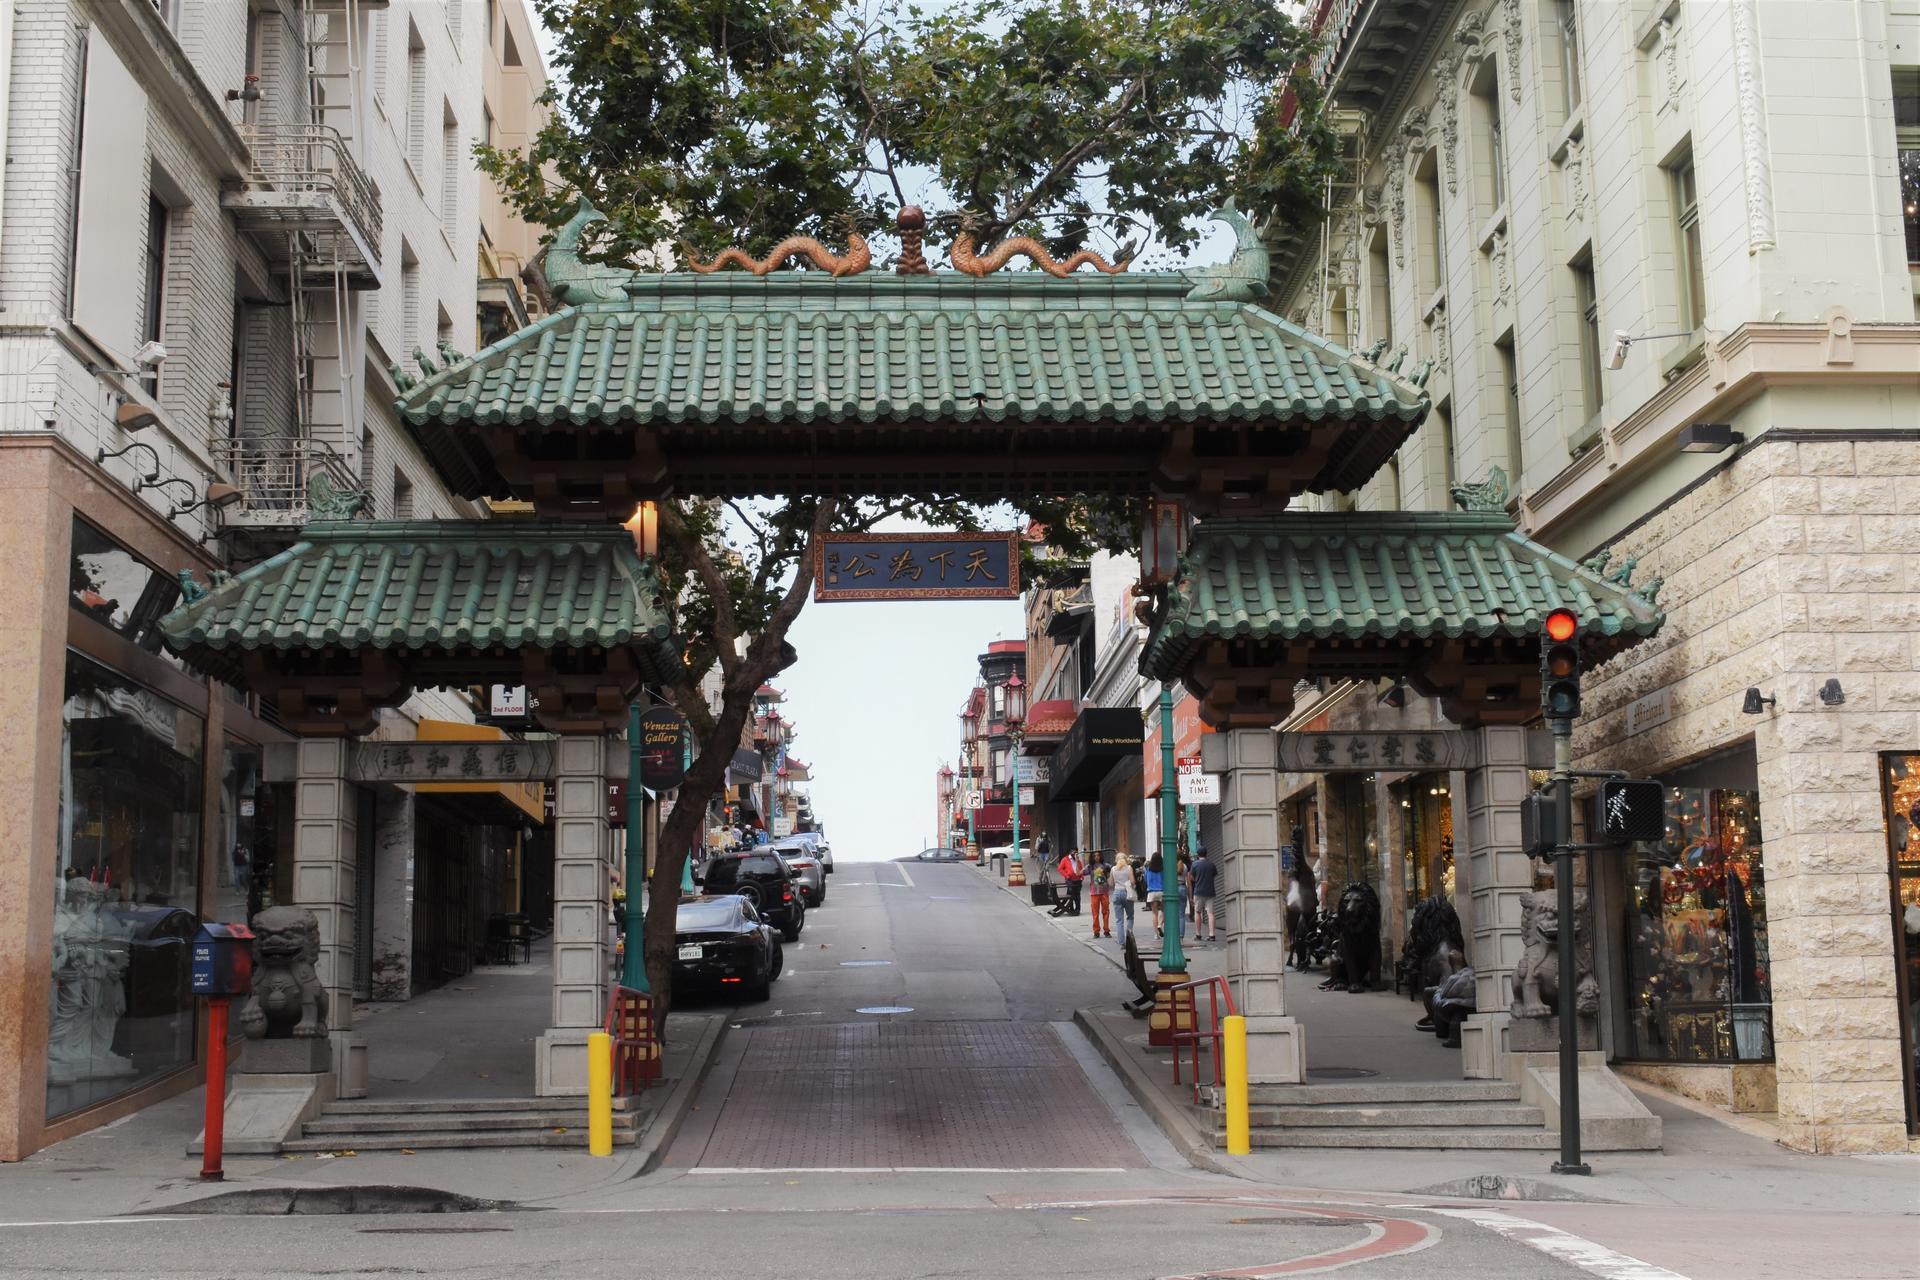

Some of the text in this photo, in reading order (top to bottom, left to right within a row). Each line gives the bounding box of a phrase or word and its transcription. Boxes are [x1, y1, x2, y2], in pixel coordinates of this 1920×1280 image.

[642, 720, 680, 730] Venezia
[645, 731, 678, 745] Gallery
[1179, 765, 1191, 774] NO
[1190, 777, 1207, 785] ANY
[1189, 786, 1210, 794] TIME
